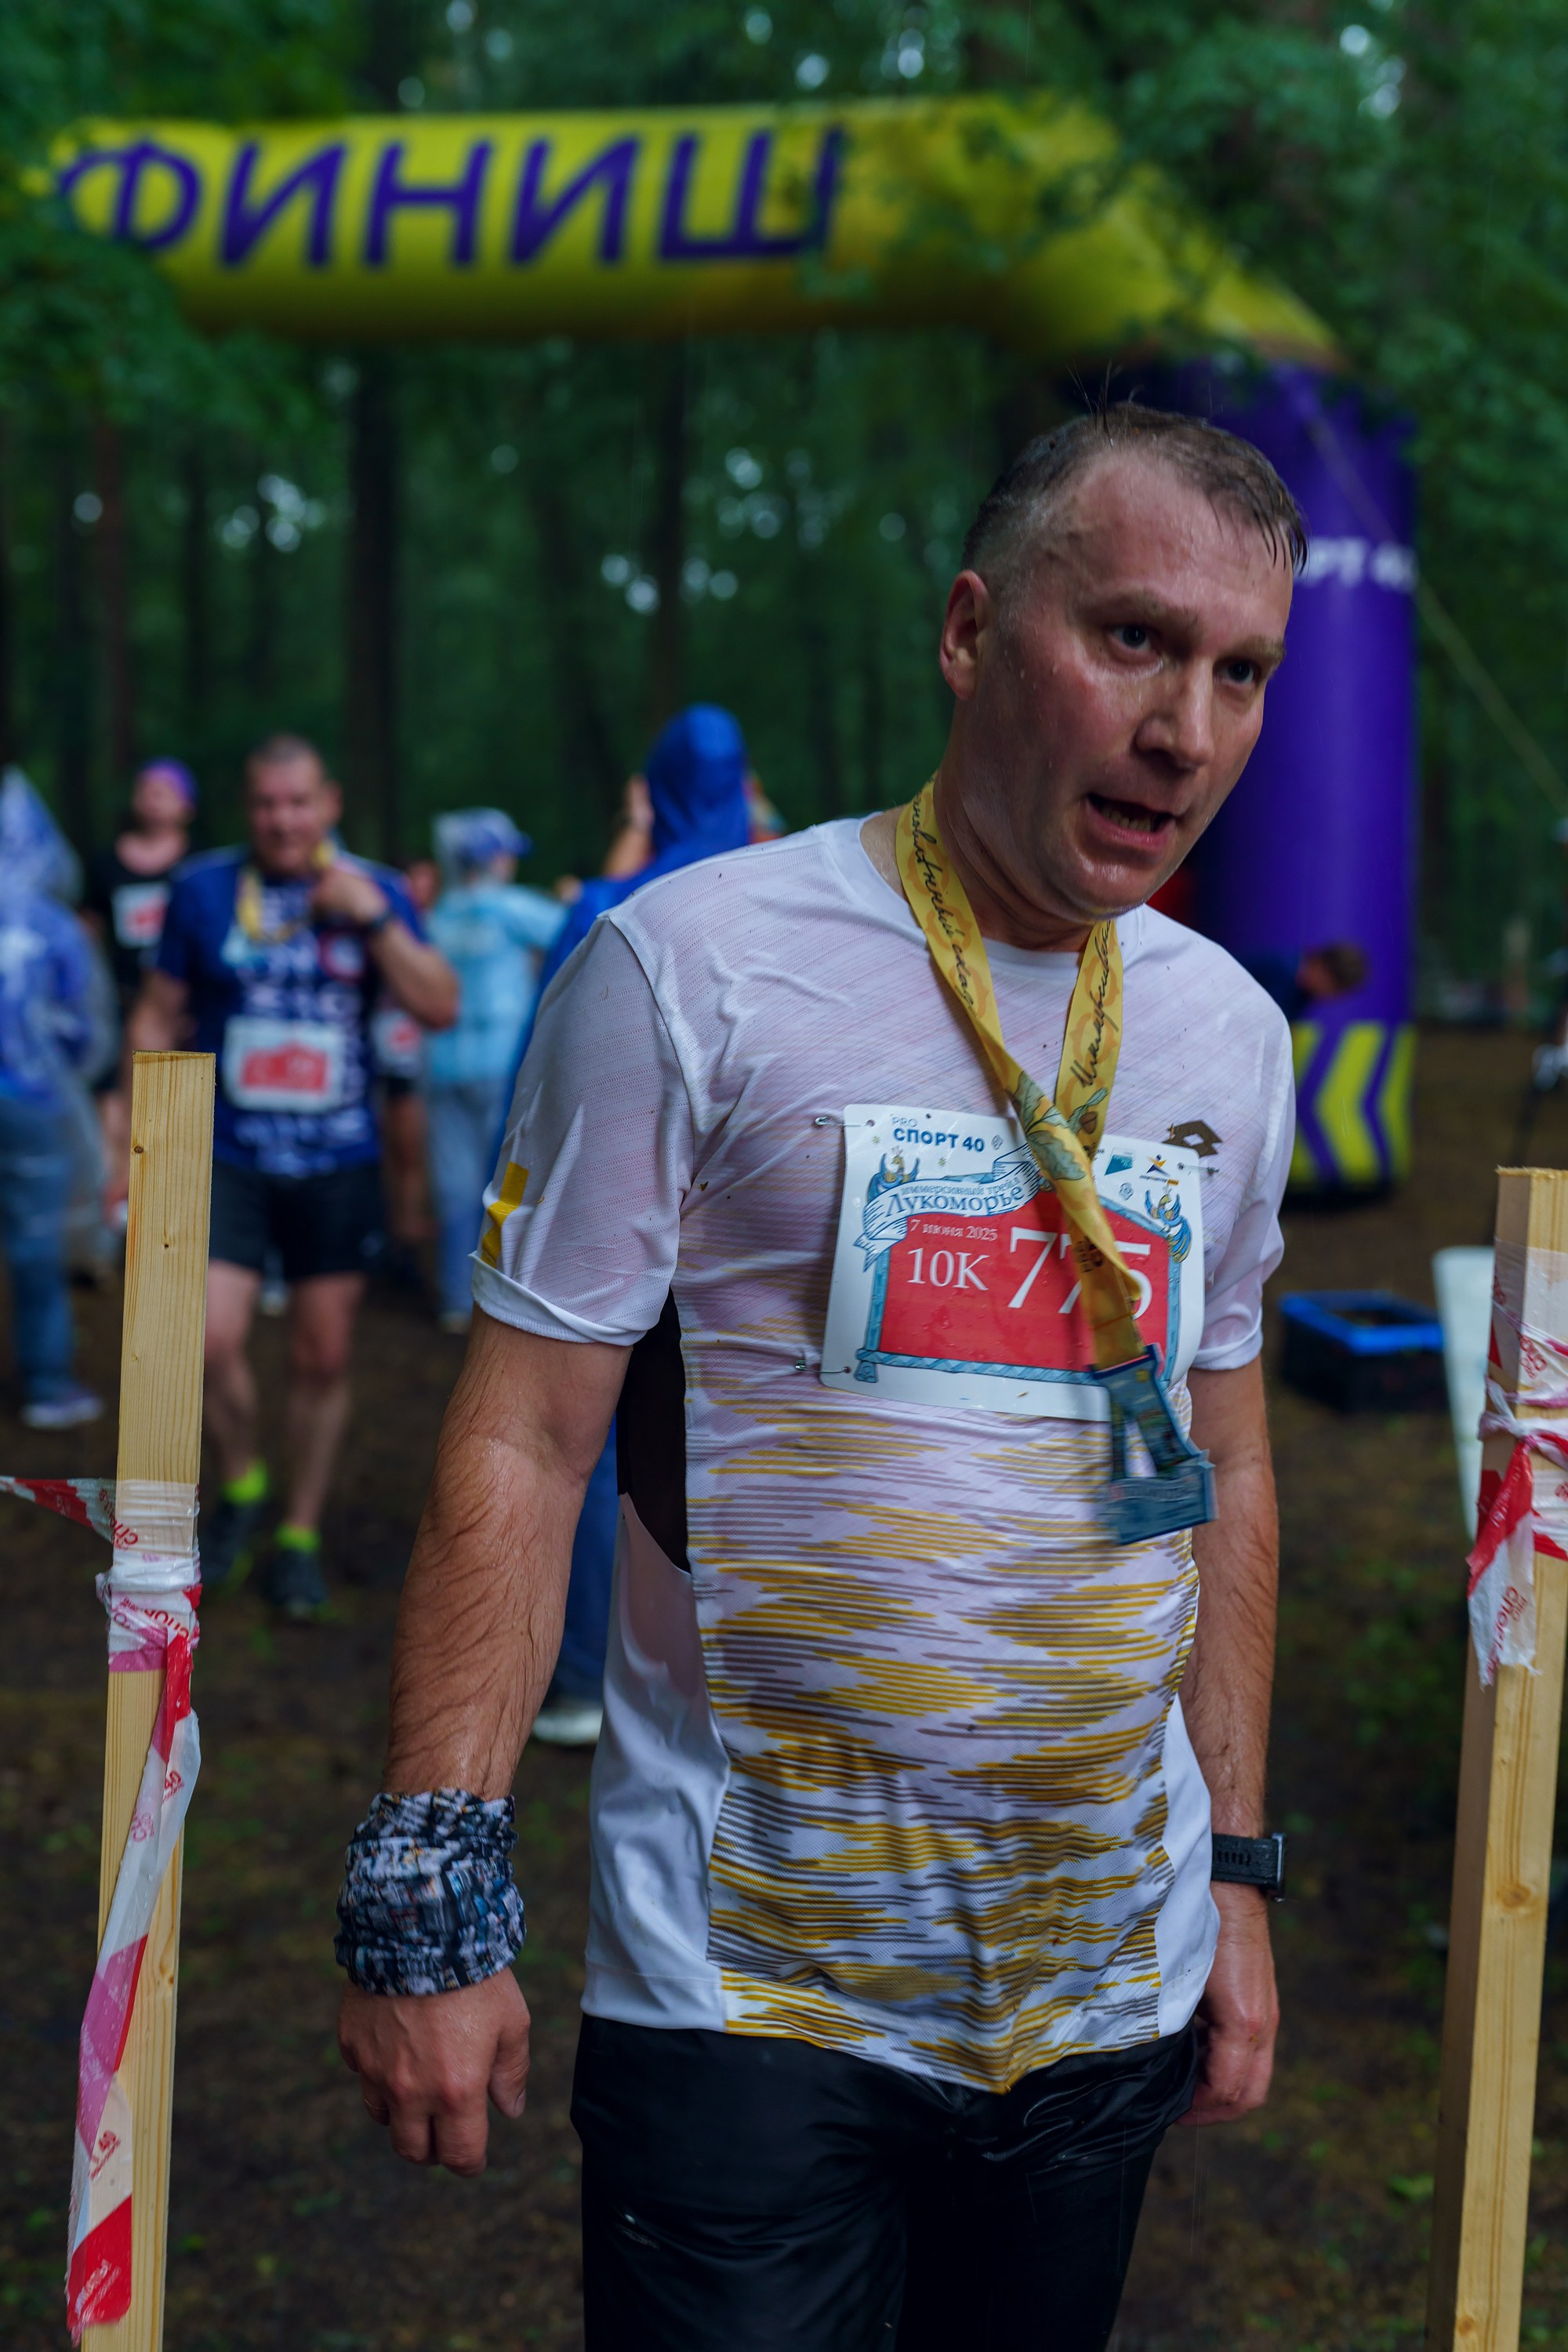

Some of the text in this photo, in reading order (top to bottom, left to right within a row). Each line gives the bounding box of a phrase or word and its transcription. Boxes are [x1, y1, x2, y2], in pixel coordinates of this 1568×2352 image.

[59, 126, 848, 269] ФИНИШ
[894, 1127, 985, 1152] СПОРТ 40
[885, 1185, 1025, 1216] Лукоморье
[910, 1219, 998, 1241] 7 июня 2025
